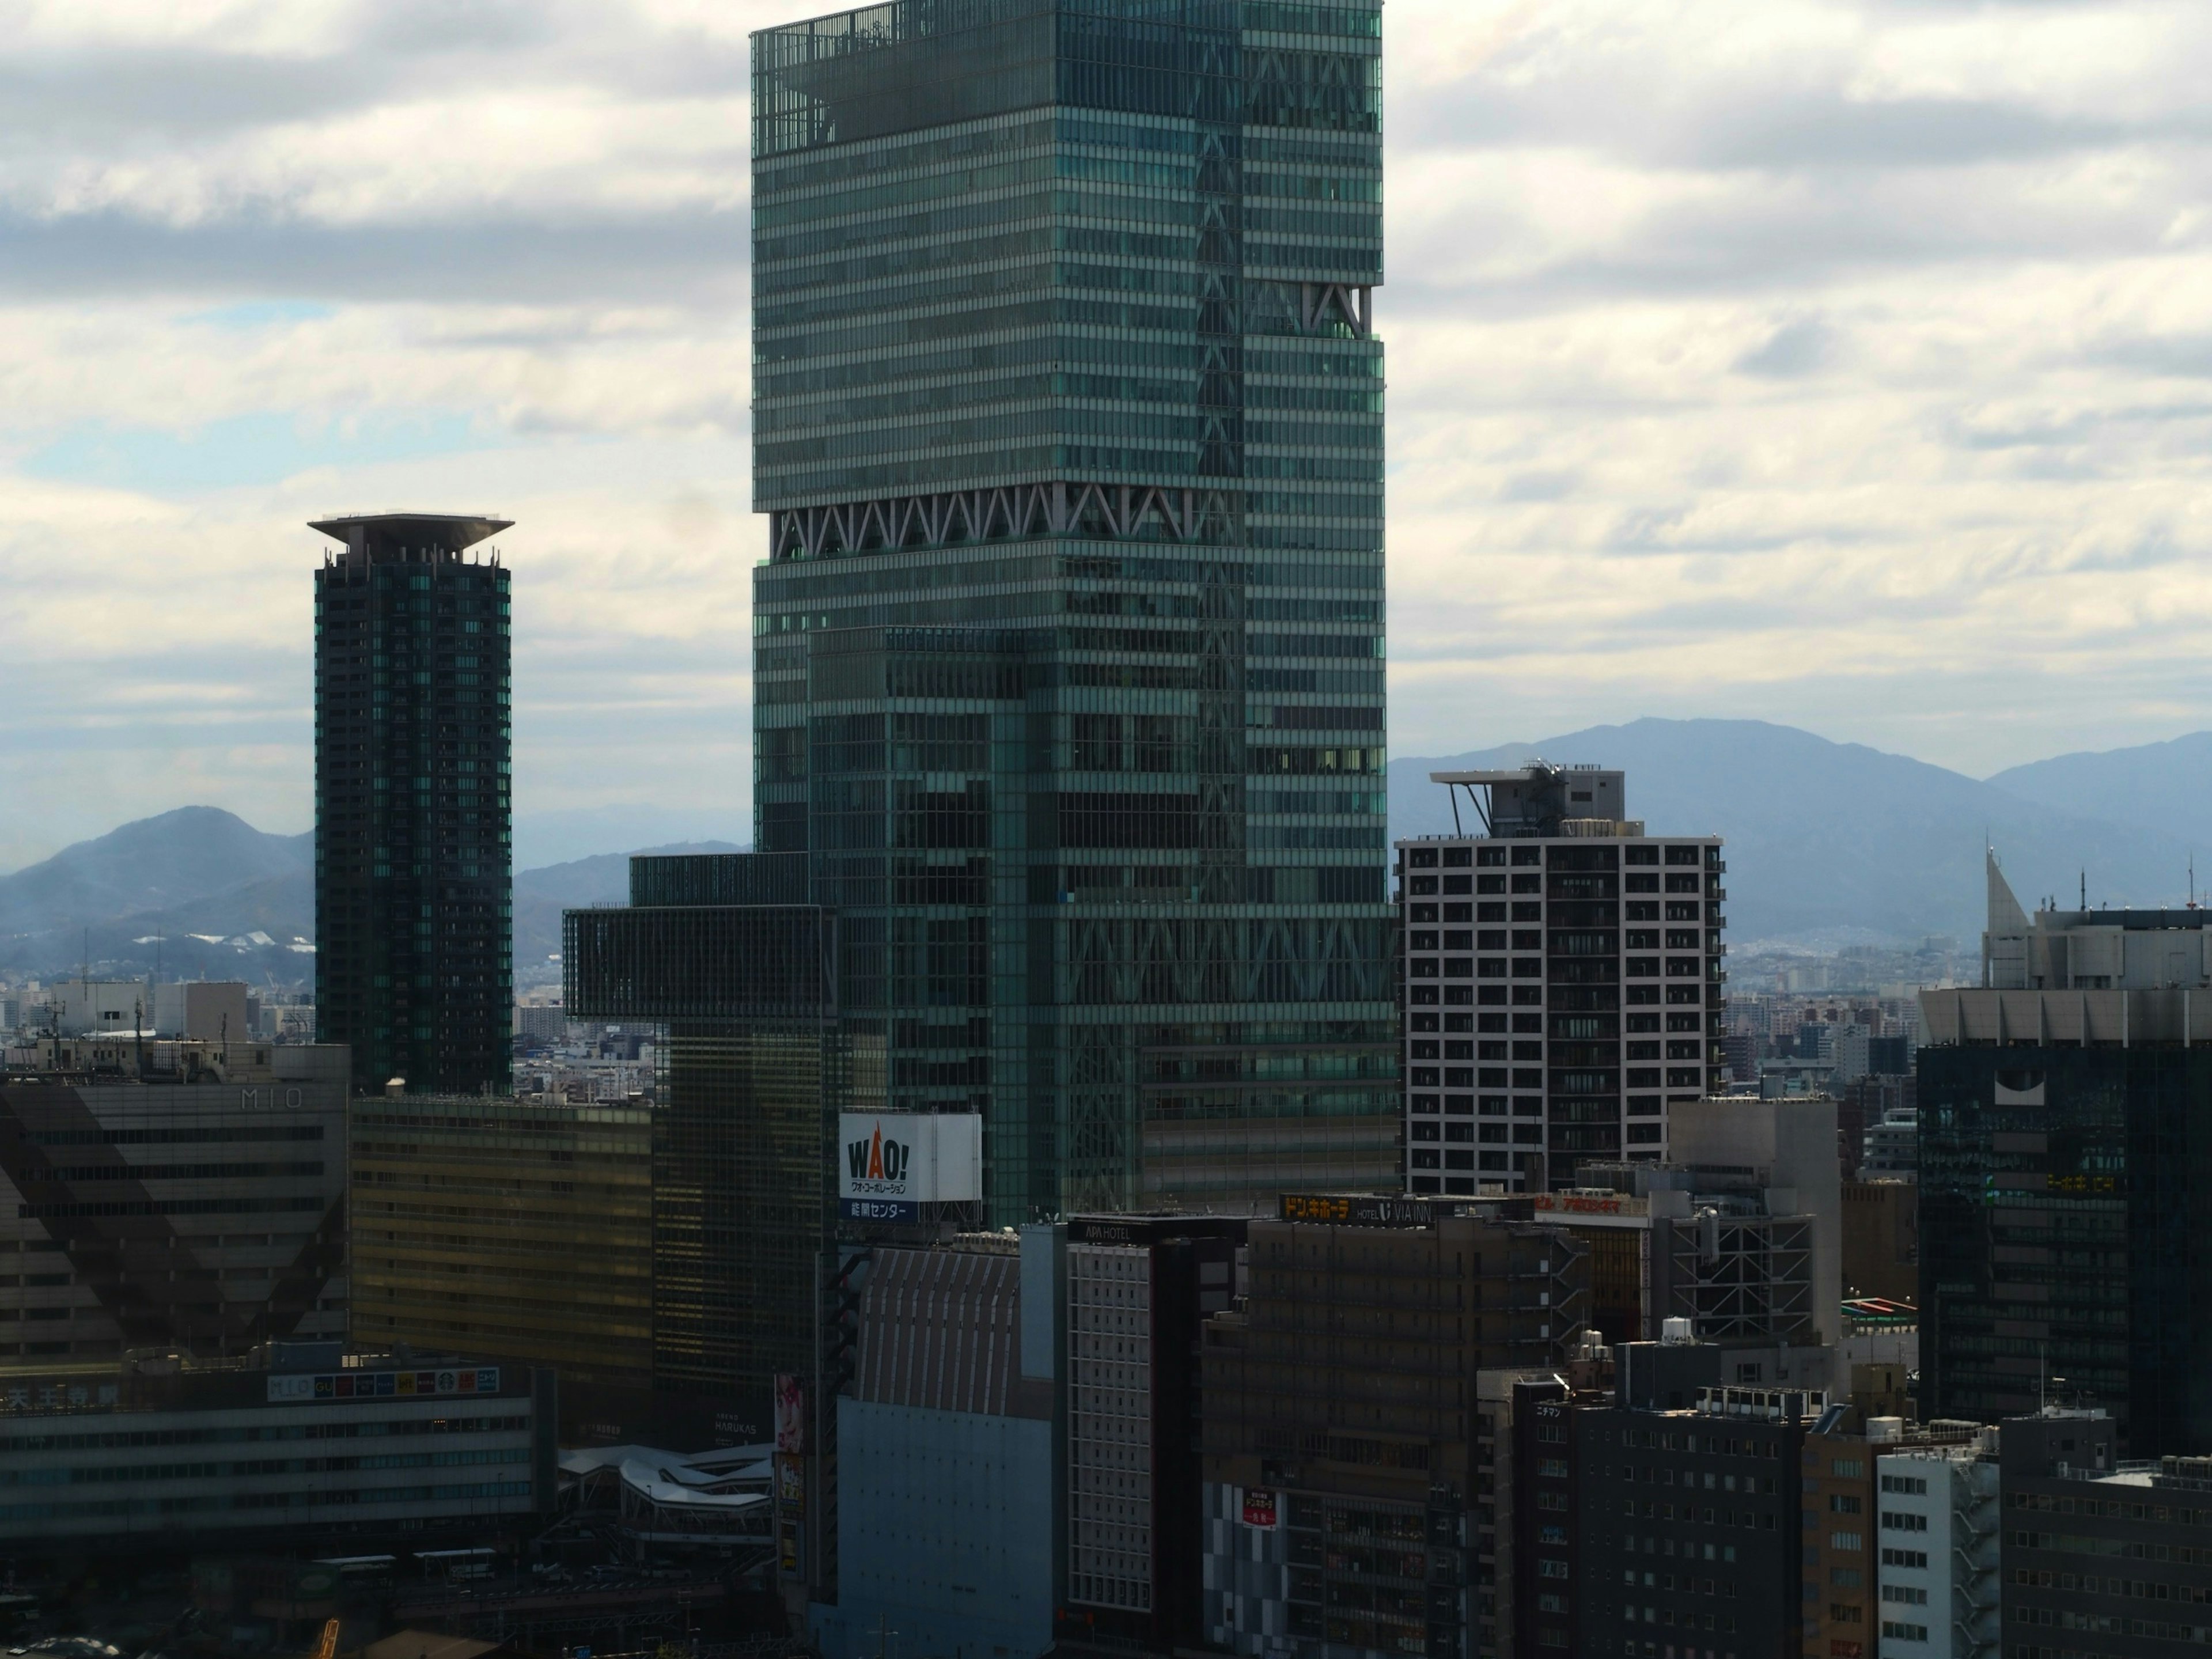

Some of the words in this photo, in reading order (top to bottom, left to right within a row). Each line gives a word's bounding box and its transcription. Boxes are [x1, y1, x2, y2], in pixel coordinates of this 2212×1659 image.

[242, 1088, 302, 1109] MIO
[848, 1120, 909, 1180] WAO!
[851, 1182, 906, 1194] ワオ・コーポレーション
[851, 1202, 906, 1218] 能開センター
[1357, 1211, 1380, 1220] HOTEL
[1393, 1203, 1412, 1221] VIA
[1413, 1205, 1431, 1222] INN
[1563, 1198, 1620, 1213] アポロシネマ
[1085, 1225, 1103, 1238] APA
[1103, 1226, 1131, 1240] HOTEL
[316, 1382, 332, 1392] GU
[716, 1412, 738, 1421] ABENO
[1536, 1407, 1561, 1418] ニチマン
[715, 1421, 757, 1435] HARUKAS
